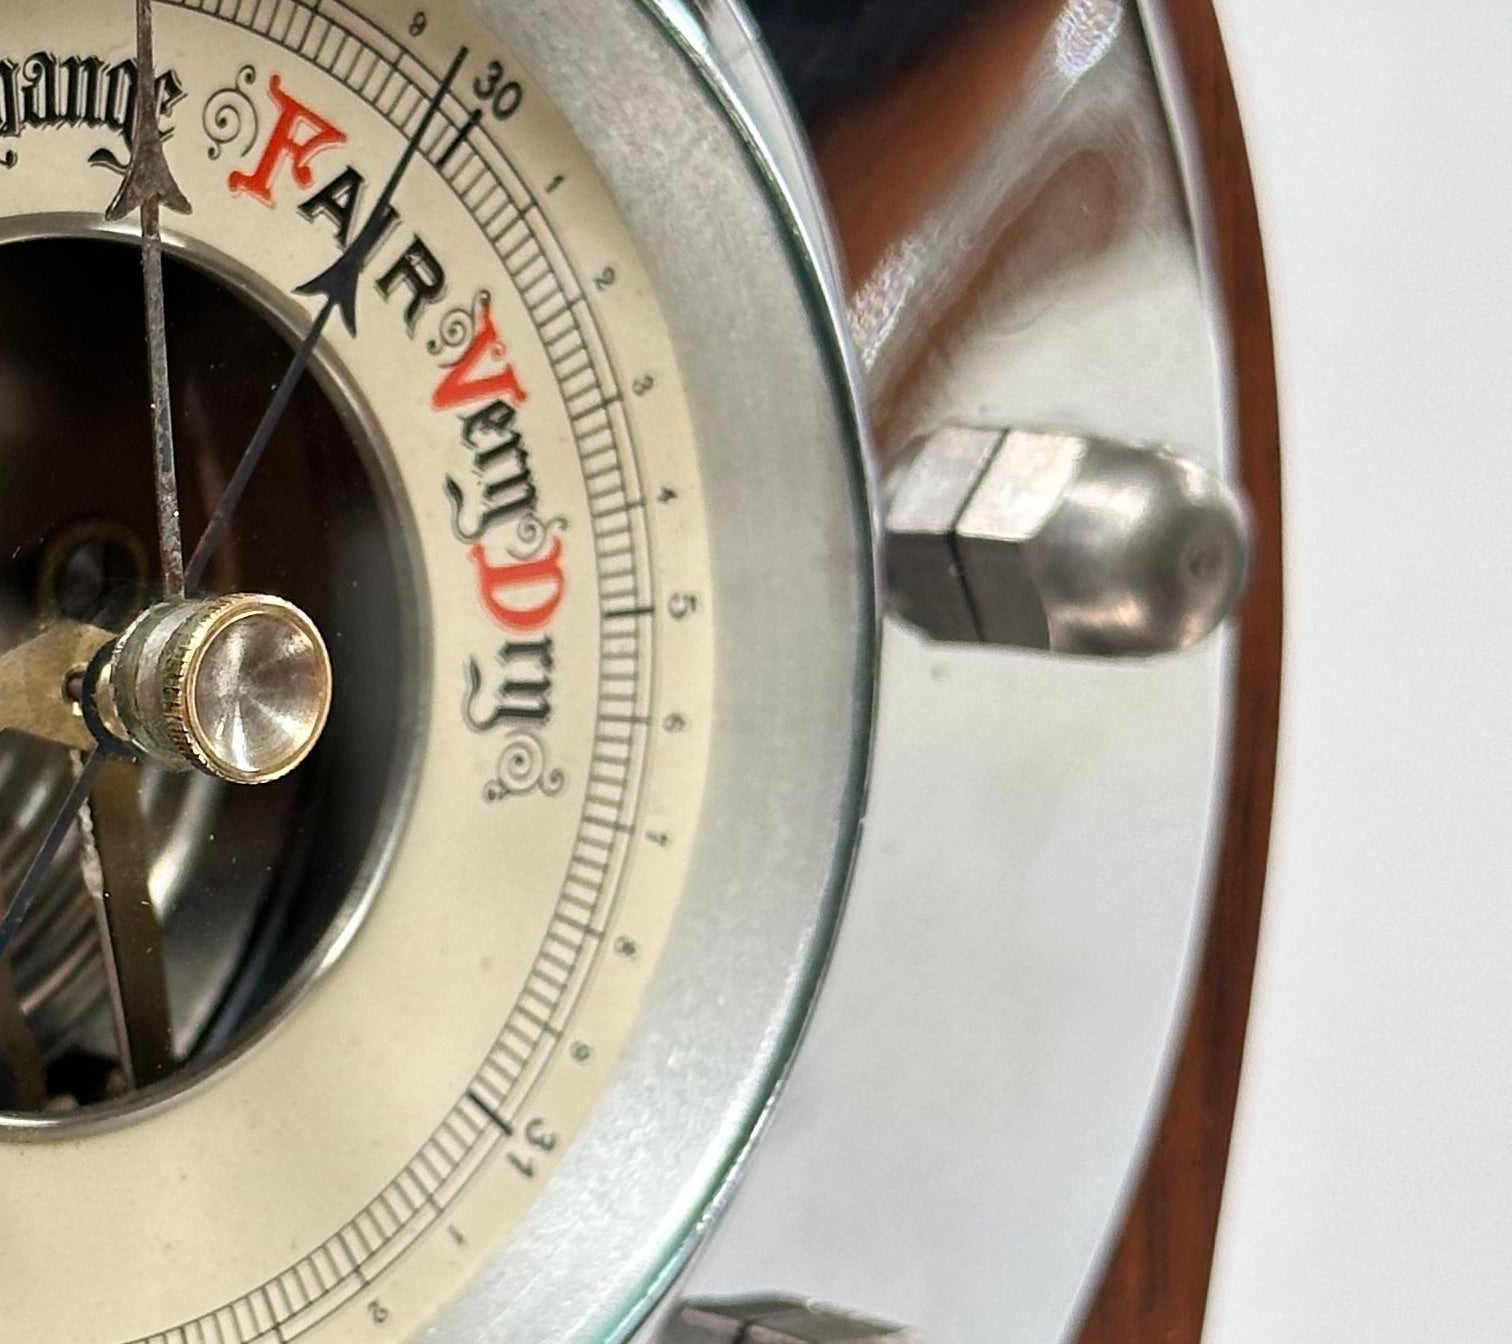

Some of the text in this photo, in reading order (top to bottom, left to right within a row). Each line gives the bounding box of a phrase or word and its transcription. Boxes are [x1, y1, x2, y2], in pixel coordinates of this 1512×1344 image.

[407, 11, 428, 37] 9
[471, 60, 524, 122] 30
[592, 267, 616, 290] 2
[631, 374, 656, 398] 3
[656, 486, 680, 507] 4
[430, 298, 566, 734] Very Dry
[668, 592, 698, 621] 5
[662, 712, 687, 734] 6
[644, 828, 670, 848] 7
[505, 1118, 557, 1180] 31
[367, 1298, 390, 1324] 2
